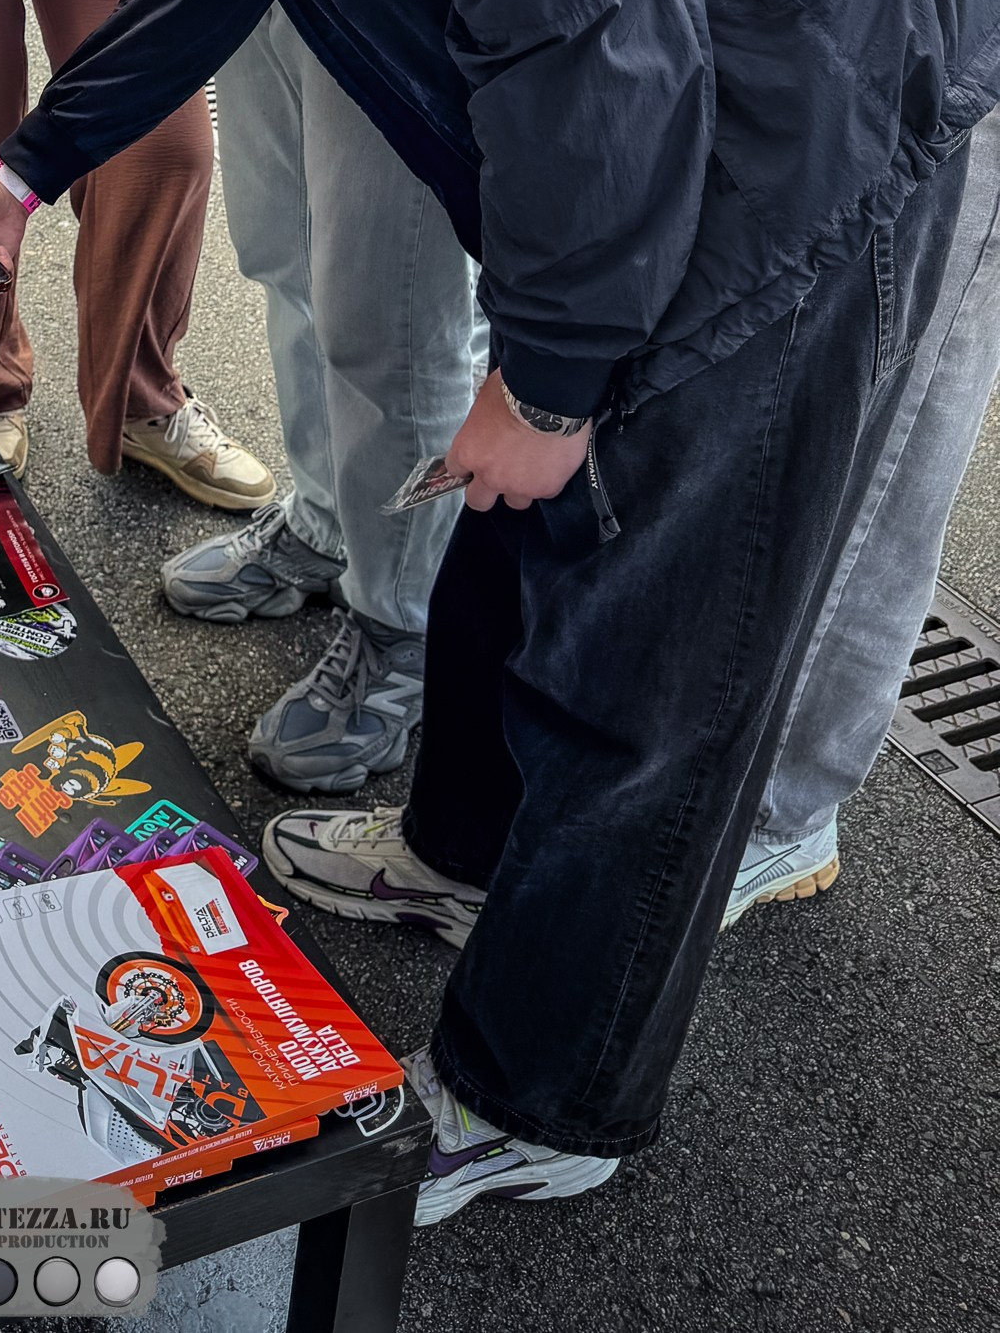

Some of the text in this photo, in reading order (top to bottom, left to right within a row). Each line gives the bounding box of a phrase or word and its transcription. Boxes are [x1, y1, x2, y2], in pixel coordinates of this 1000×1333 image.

[586, 441, 599, 490] COMPANY
[0, 621, 53, 641] CONTEST
[25, 632, 50, 645] ADM
[194, 908, 212, 940] DELTA
[238, 960, 340, 1072] АККУМУЛЯТОРОВ
[226, 997, 299, 1086] ПРИМЕНЯЕМОСТИ
[320, 1024, 361, 1067] DELTA
[250, 1048, 287, 1091] КАТАЛОГ
[277, 1041, 318, 1081] МОТО
[343, 1081, 379, 1103] DELTA
[235, 1128, 254, 1143] КАТАЛОГ
[252, 1134, 292, 1153] DELTA
[164, 1169, 204, 1188] DELTA
